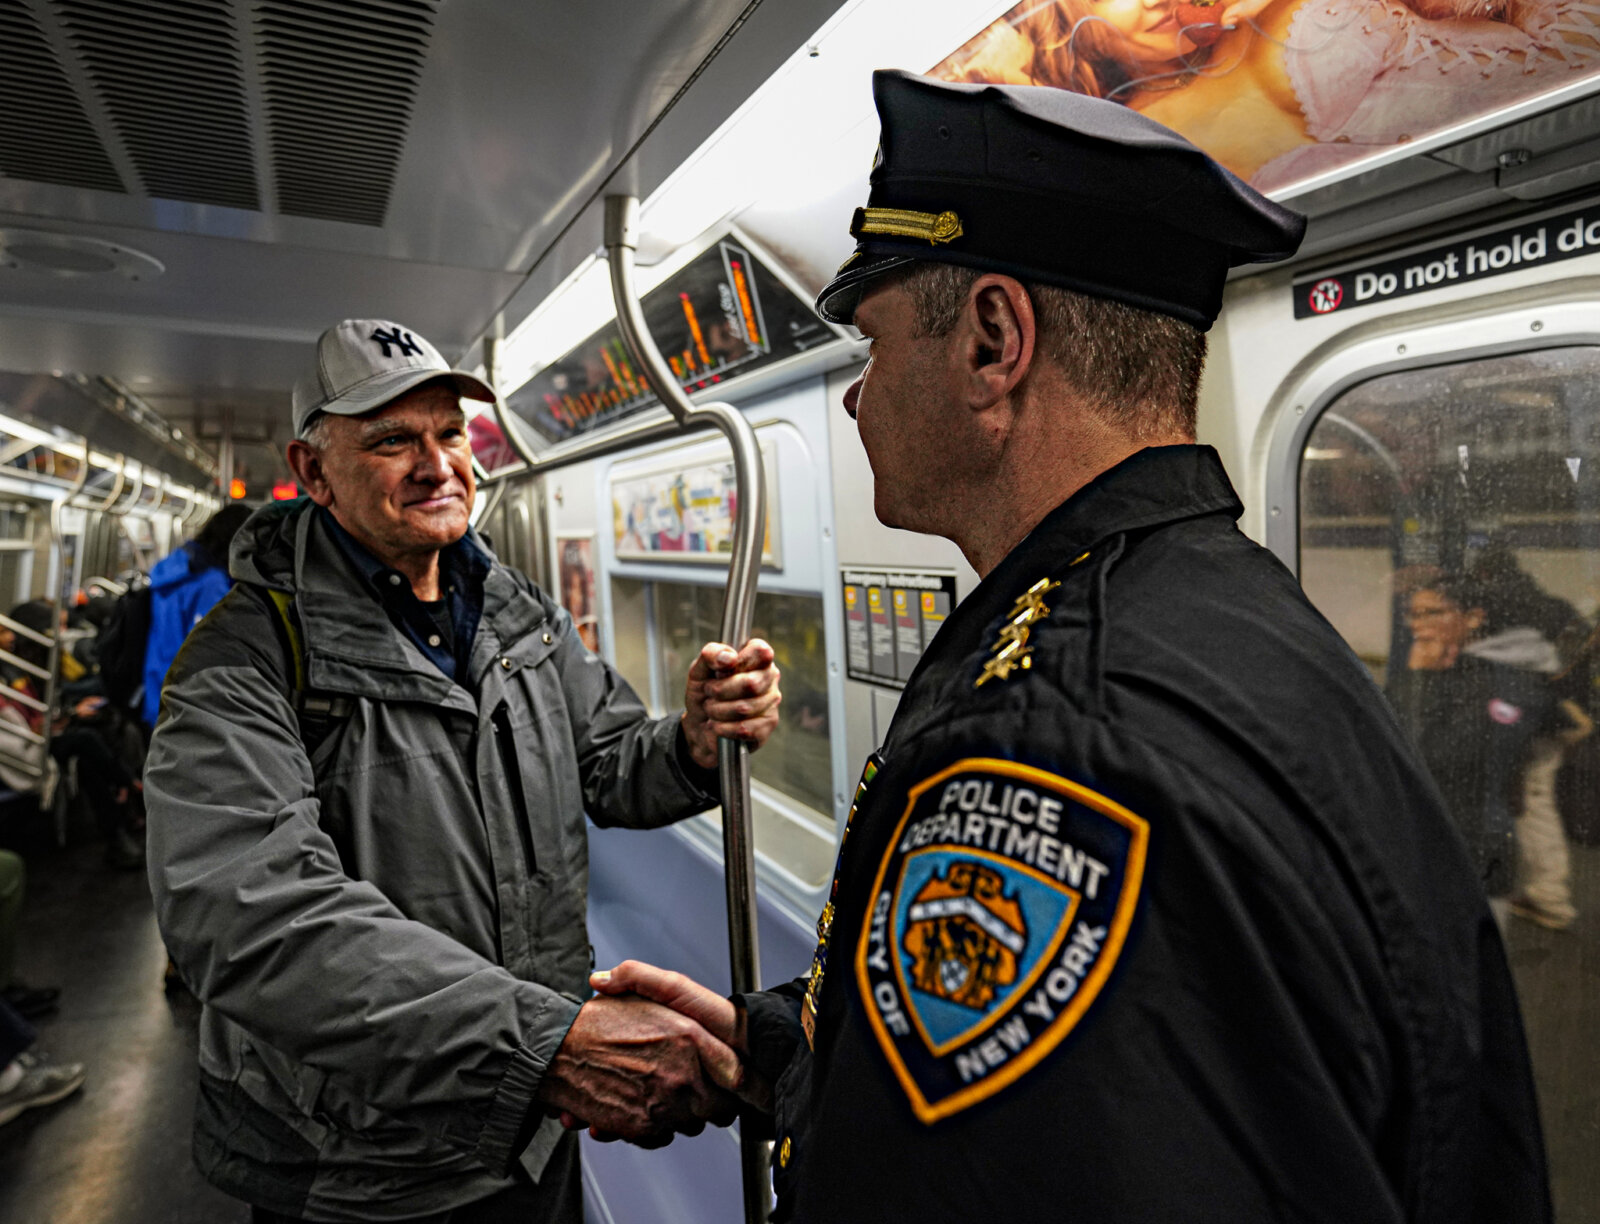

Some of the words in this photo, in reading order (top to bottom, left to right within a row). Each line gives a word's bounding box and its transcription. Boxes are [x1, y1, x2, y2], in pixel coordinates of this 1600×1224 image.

[1355, 272, 1398, 301] Do
[1404, 254, 1459, 289] not
[1466, 228, 1546, 274] hold
[939, 780, 1063, 834] POLICE
[900, 812, 1110, 900] DEPARTMENT
[867, 890, 892, 972] CITY
[875, 981, 910, 1036] OF
[955, 1015, 1030, 1082] NEW
[1024, 920, 1107, 1022] YORK
